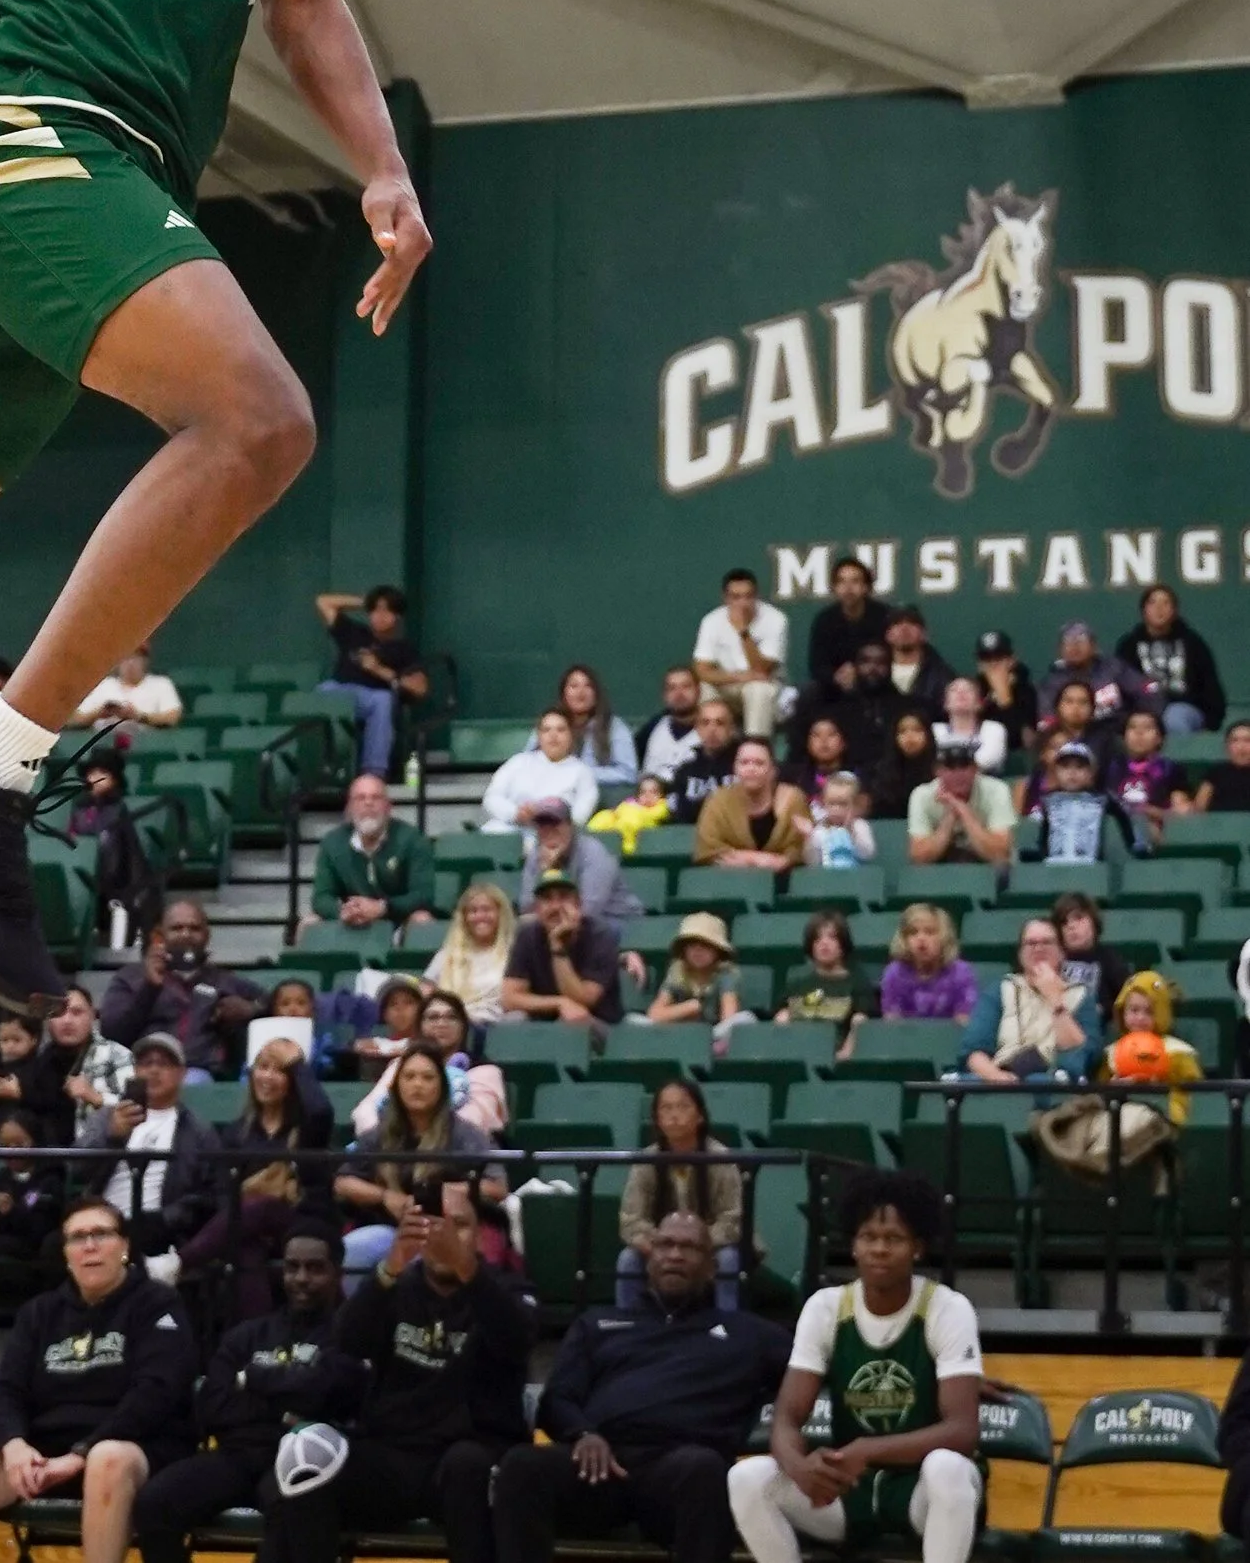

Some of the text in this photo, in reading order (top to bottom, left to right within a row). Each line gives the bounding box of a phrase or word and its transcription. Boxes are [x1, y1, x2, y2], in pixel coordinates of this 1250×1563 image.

[661, 274, 1250, 494] CAL PO
[774, 529, 1250, 599] MUSTANG
[1094, 1406, 1195, 1434] CAL POLY
